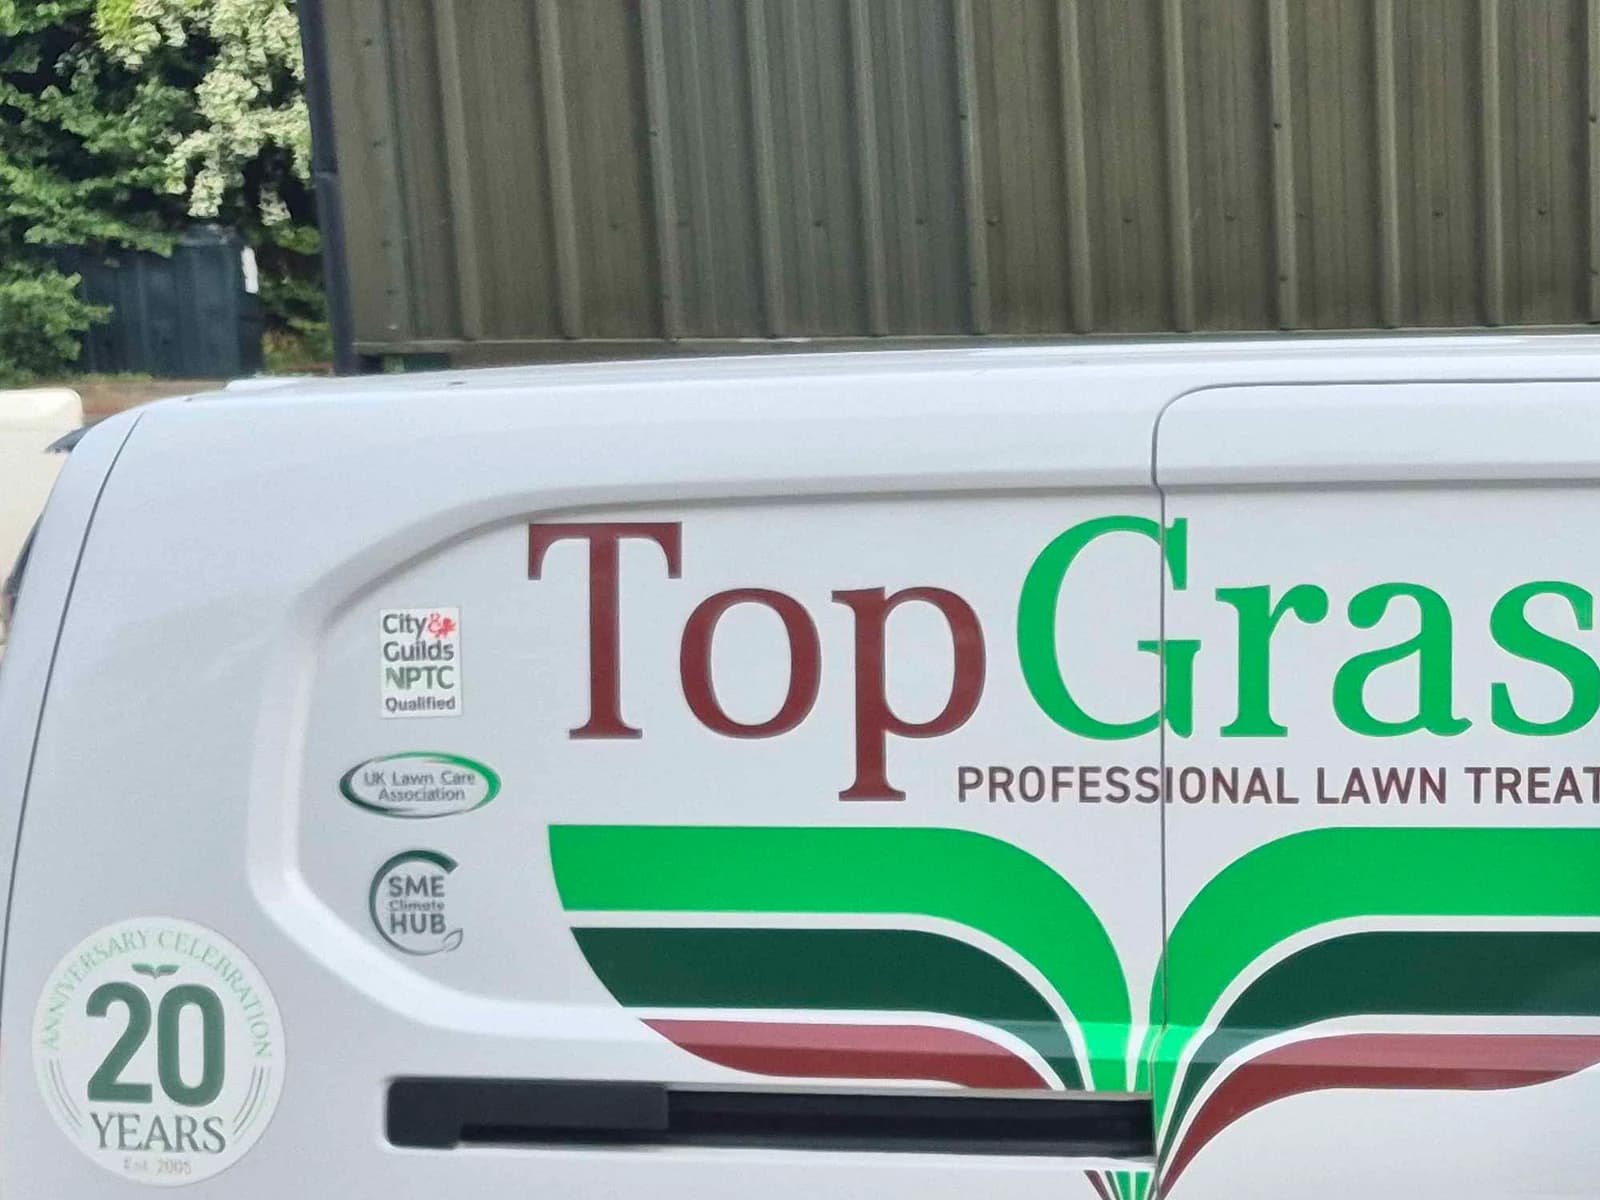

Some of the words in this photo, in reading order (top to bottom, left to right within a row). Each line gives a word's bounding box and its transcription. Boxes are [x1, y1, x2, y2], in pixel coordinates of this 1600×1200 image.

[383, 640, 455, 662] Guilds
[385, 665, 454, 690] NPTC
[385, 696, 456, 713] Qualified
[364, 770, 387, 787] UK
[392, 771, 434, 786] Lawn
[440, 771, 476, 786] Care
[958, 765, 1299, 804] PROFESSIONAL
[1316, 766, 1447, 804] LAWN
[378, 786, 466, 801] Association
[388, 874, 446, 898] SME
[389, 900, 446, 912] Climate
[390, 913, 447, 935] HUB
[41, 929, 149, 1050] ANNIVERSARY
[158, 929, 273, 1058] CELEBRATION
[86, 981, 226, 1108] 20
[90, 1112, 227, 1154] YEARS
